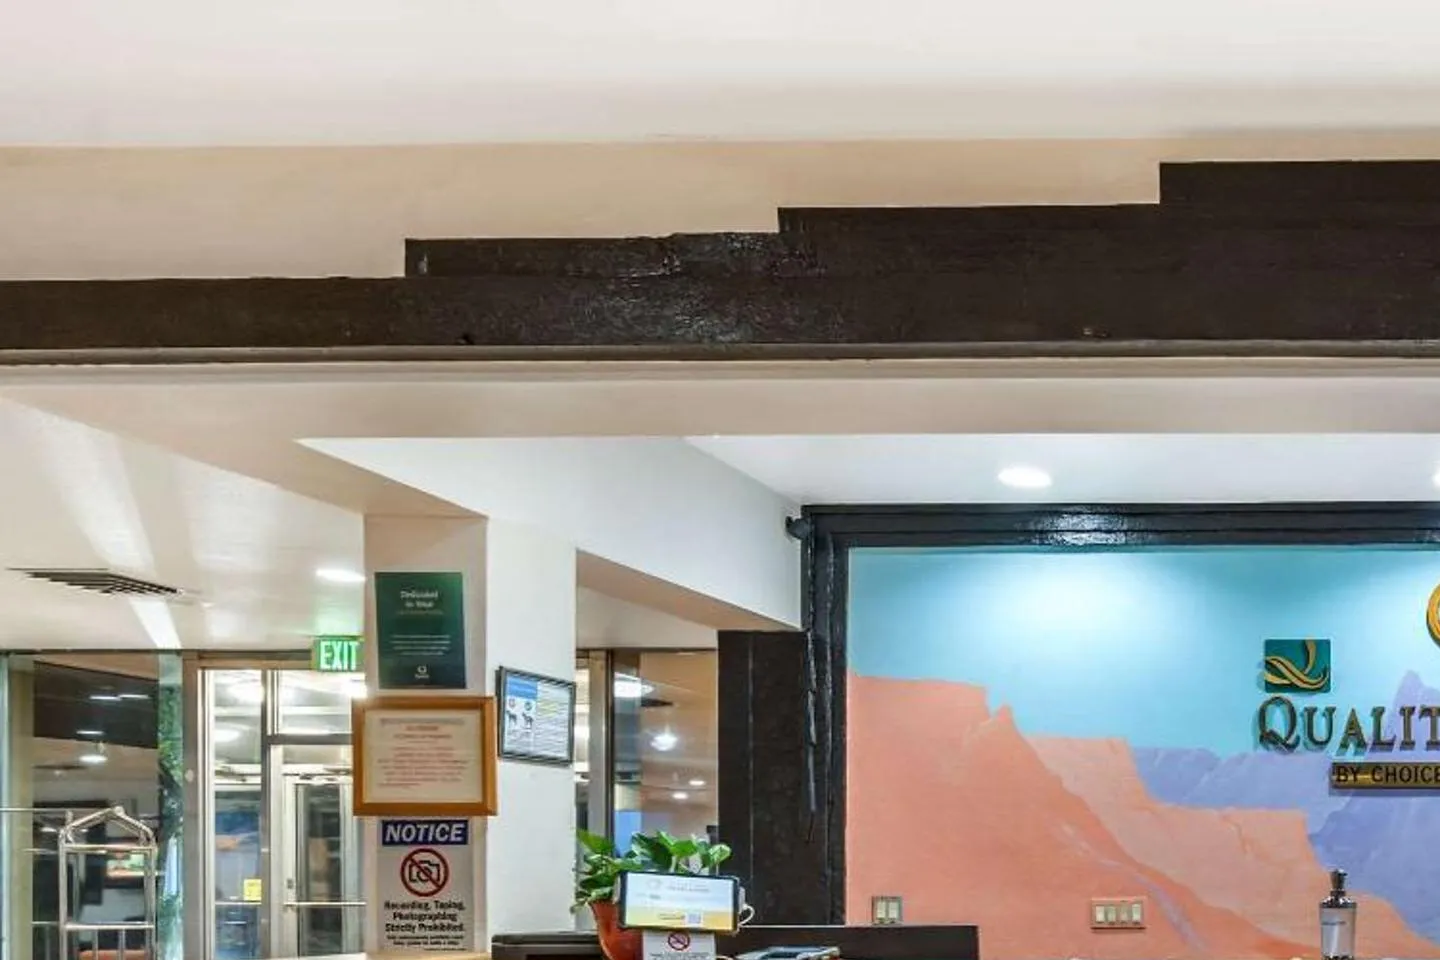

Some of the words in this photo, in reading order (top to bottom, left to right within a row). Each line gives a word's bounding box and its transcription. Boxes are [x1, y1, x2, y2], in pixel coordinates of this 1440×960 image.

[320, 640, 358, 670] EXIT
[1335, 765, 1360, 783] BY
[385, 823, 465, 841] NOTICE
[393, 912, 458, 921] Photographing
[385, 923, 416, 933] Strictly
